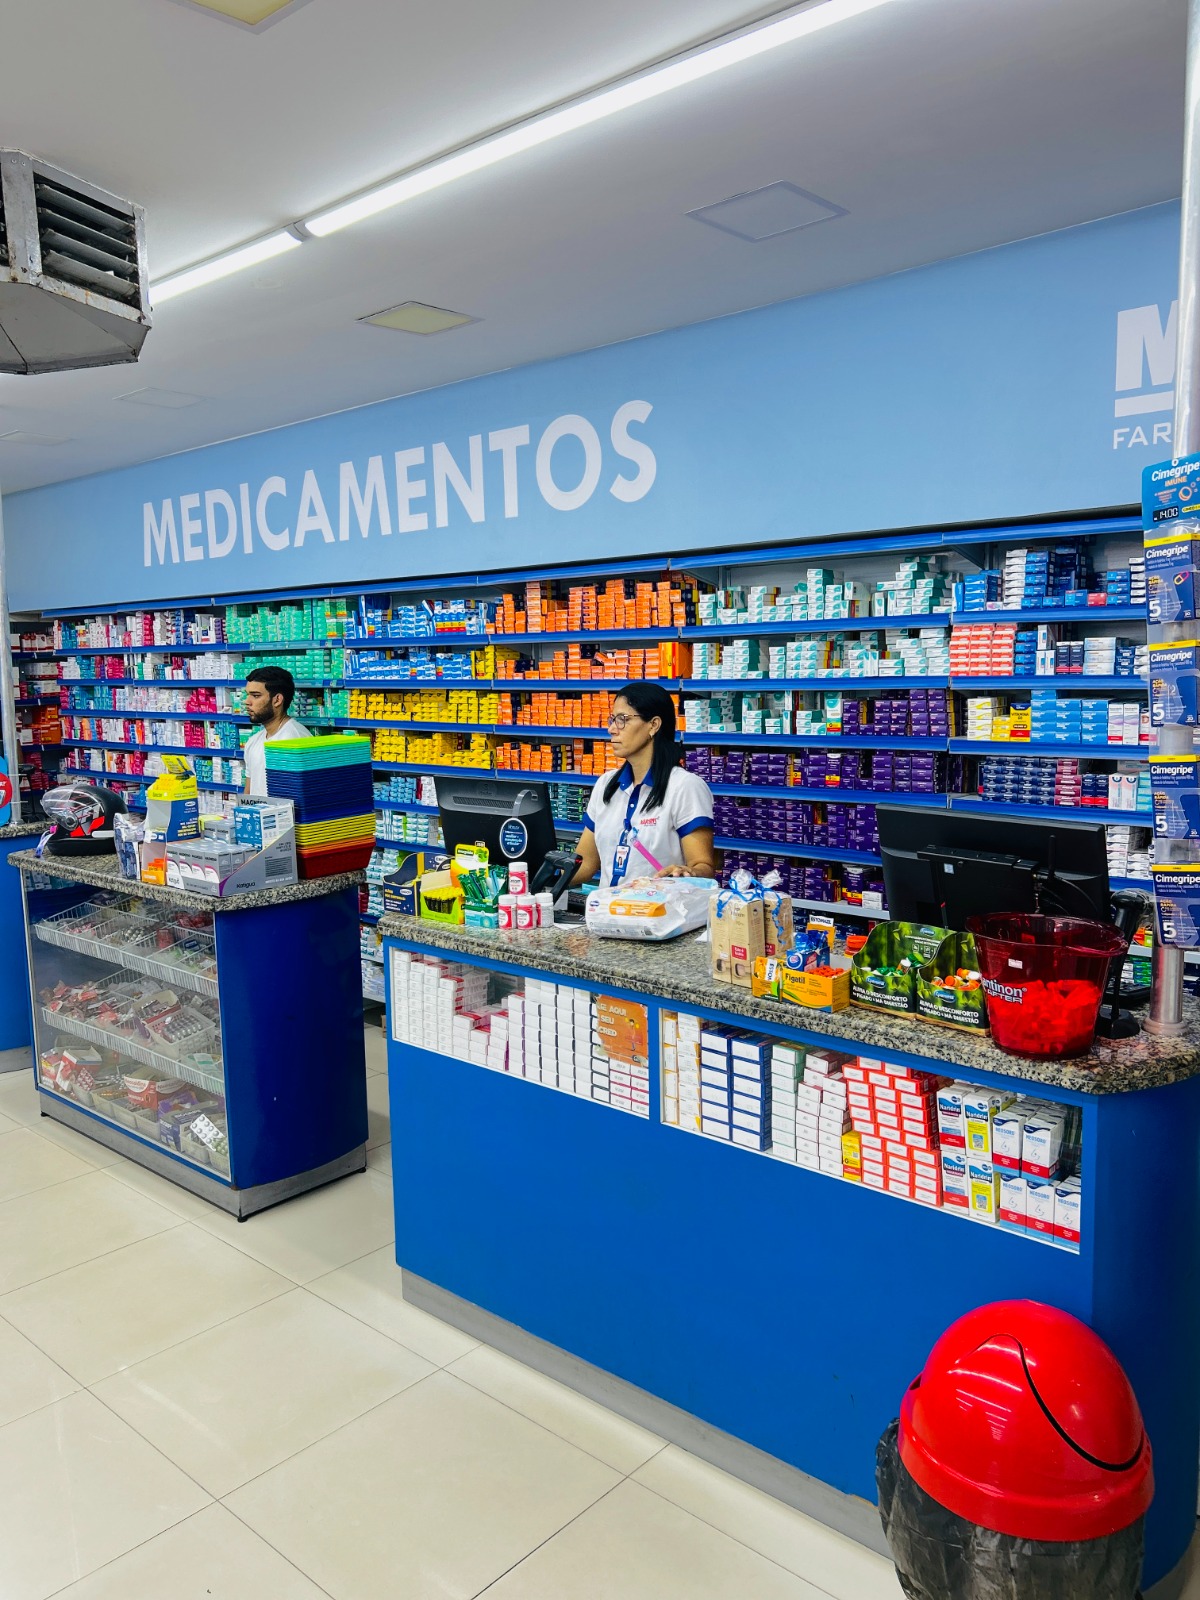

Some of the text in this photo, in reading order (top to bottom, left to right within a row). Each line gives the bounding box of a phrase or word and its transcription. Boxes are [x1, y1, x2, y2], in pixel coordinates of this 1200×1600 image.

[1151, 461, 1200, 482] Cimegripe
[142, 399, 657, 568] MEDICAMENTOS
[1146, 544, 1189, 560] Cimegripe
[1149, 600, 1162, 618] 5
[1150, 650, 1193, 663] Cimegripe
[1152, 703, 1165, 720] 5
[1151, 764, 1194, 776] Cimegripe
[1155, 815, 1168, 832] 5
[1155, 873, 1200, 885] Cimegripe
[1162, 921, 1177, 939] 5
[609, 1005, 627, 1017] AQUI
[600, 1014, 615, 1025] SEU
